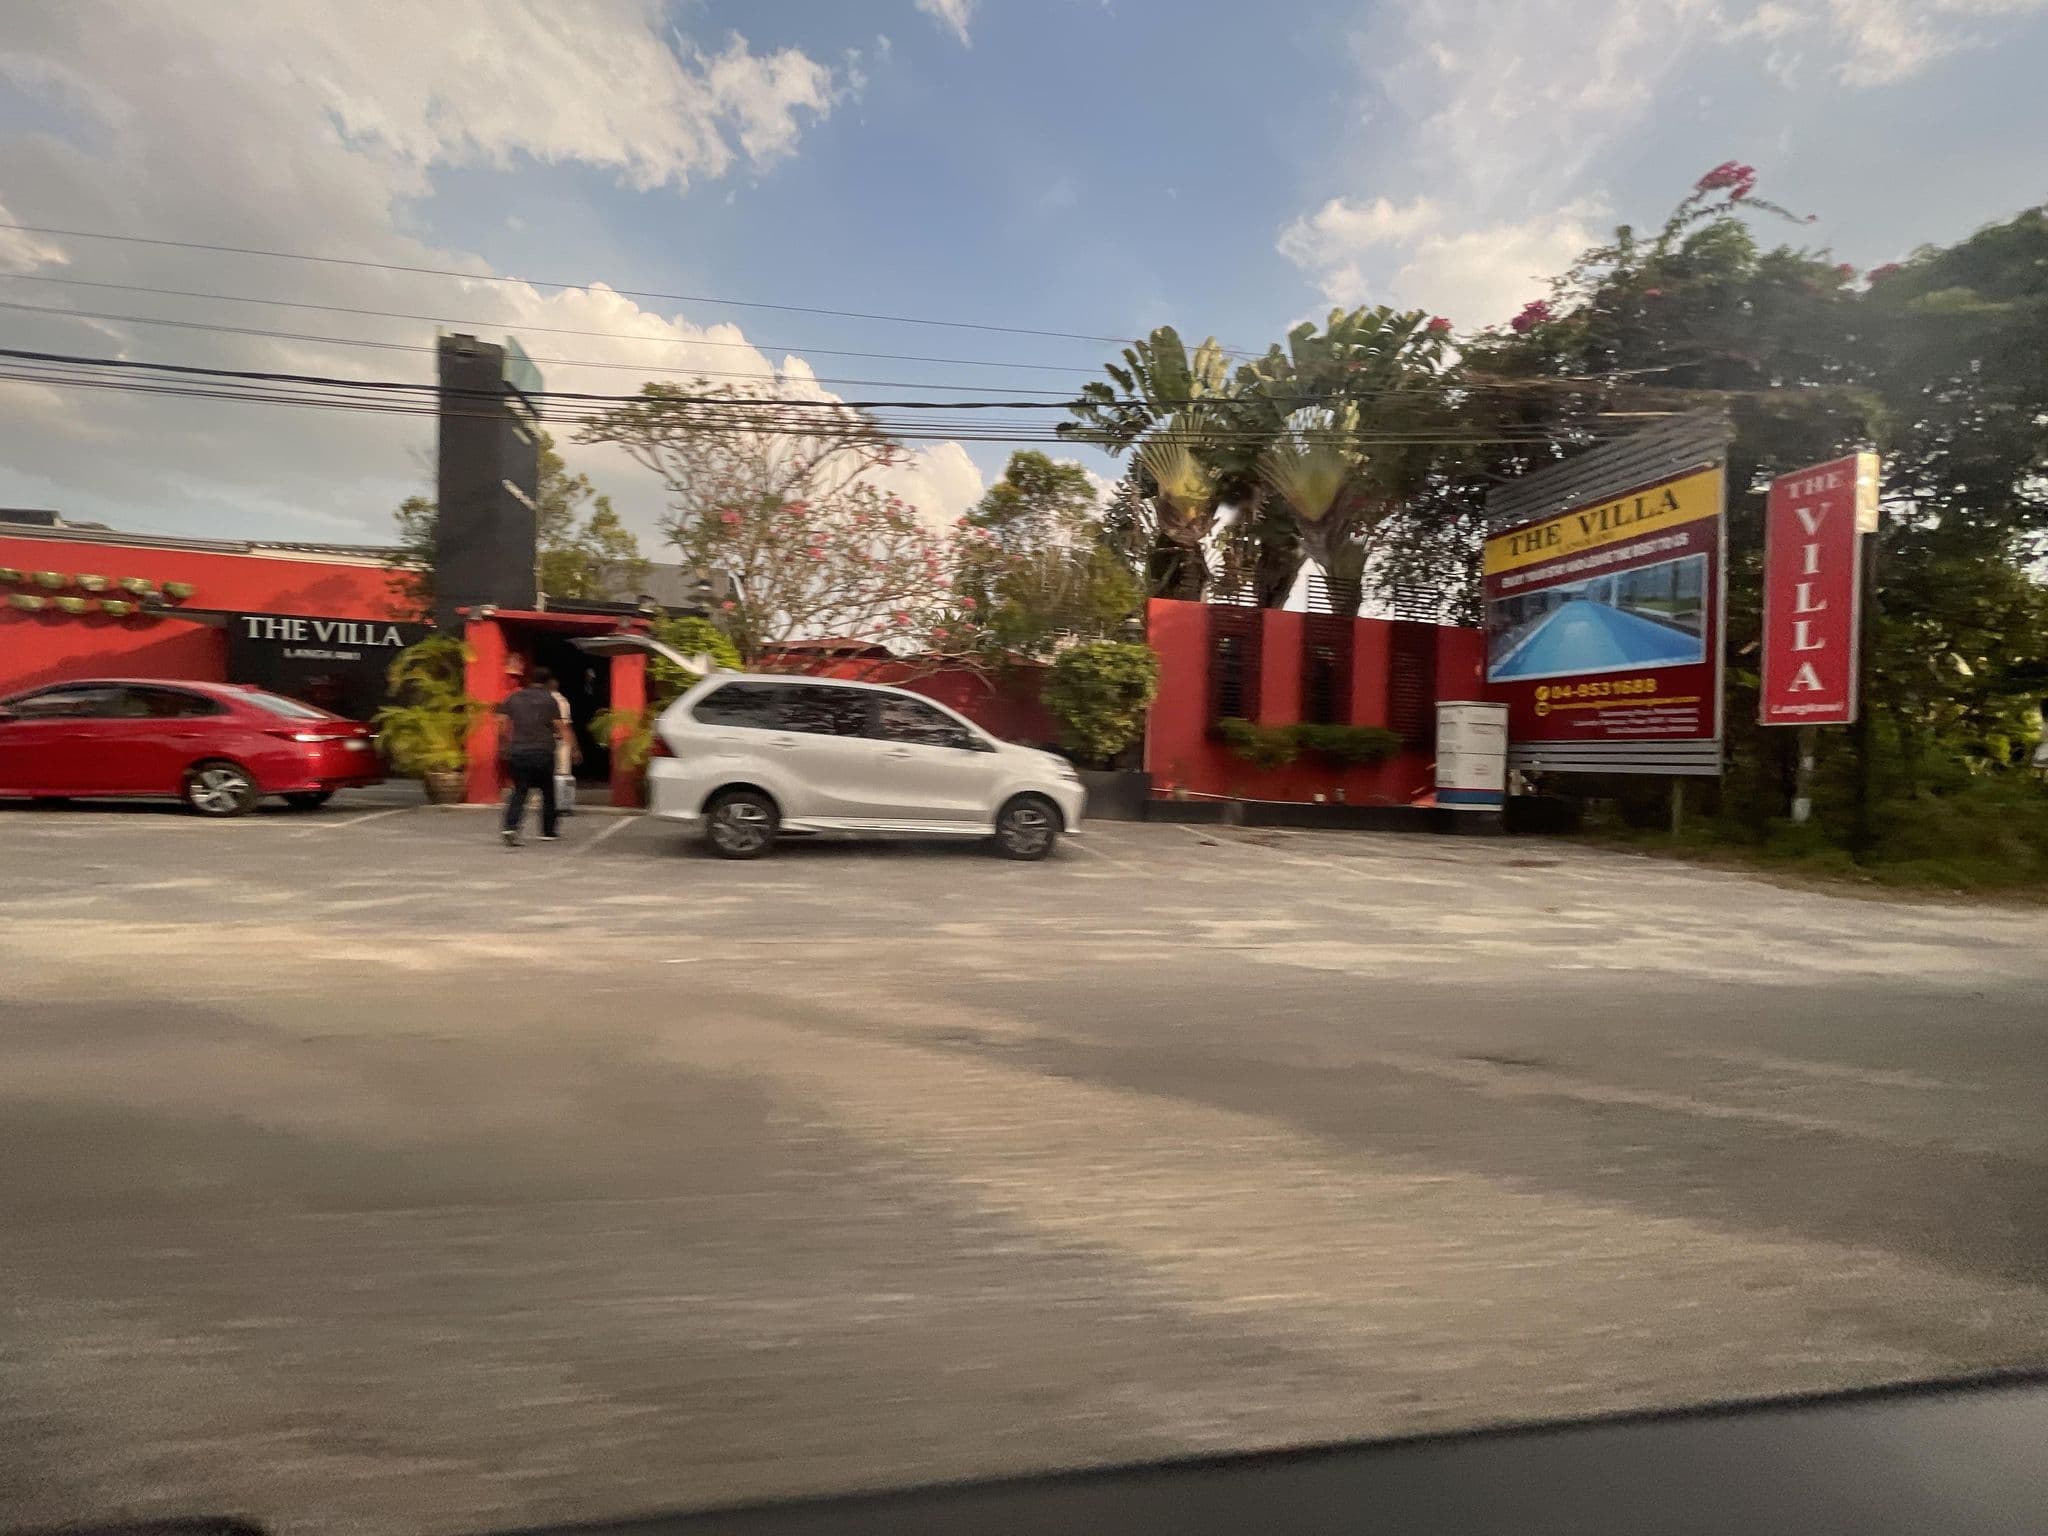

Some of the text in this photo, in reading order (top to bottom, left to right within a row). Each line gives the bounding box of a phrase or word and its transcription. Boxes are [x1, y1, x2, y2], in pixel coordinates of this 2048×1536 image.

[1784, 471, 1844, 499] THE
[1509, 523, 1562, 556] THE
[1577, 488, 1681, 535] VILLA
[1787, 502, 1832, 693] VILLA
[241, 616, 405, 647] THE VILLA
